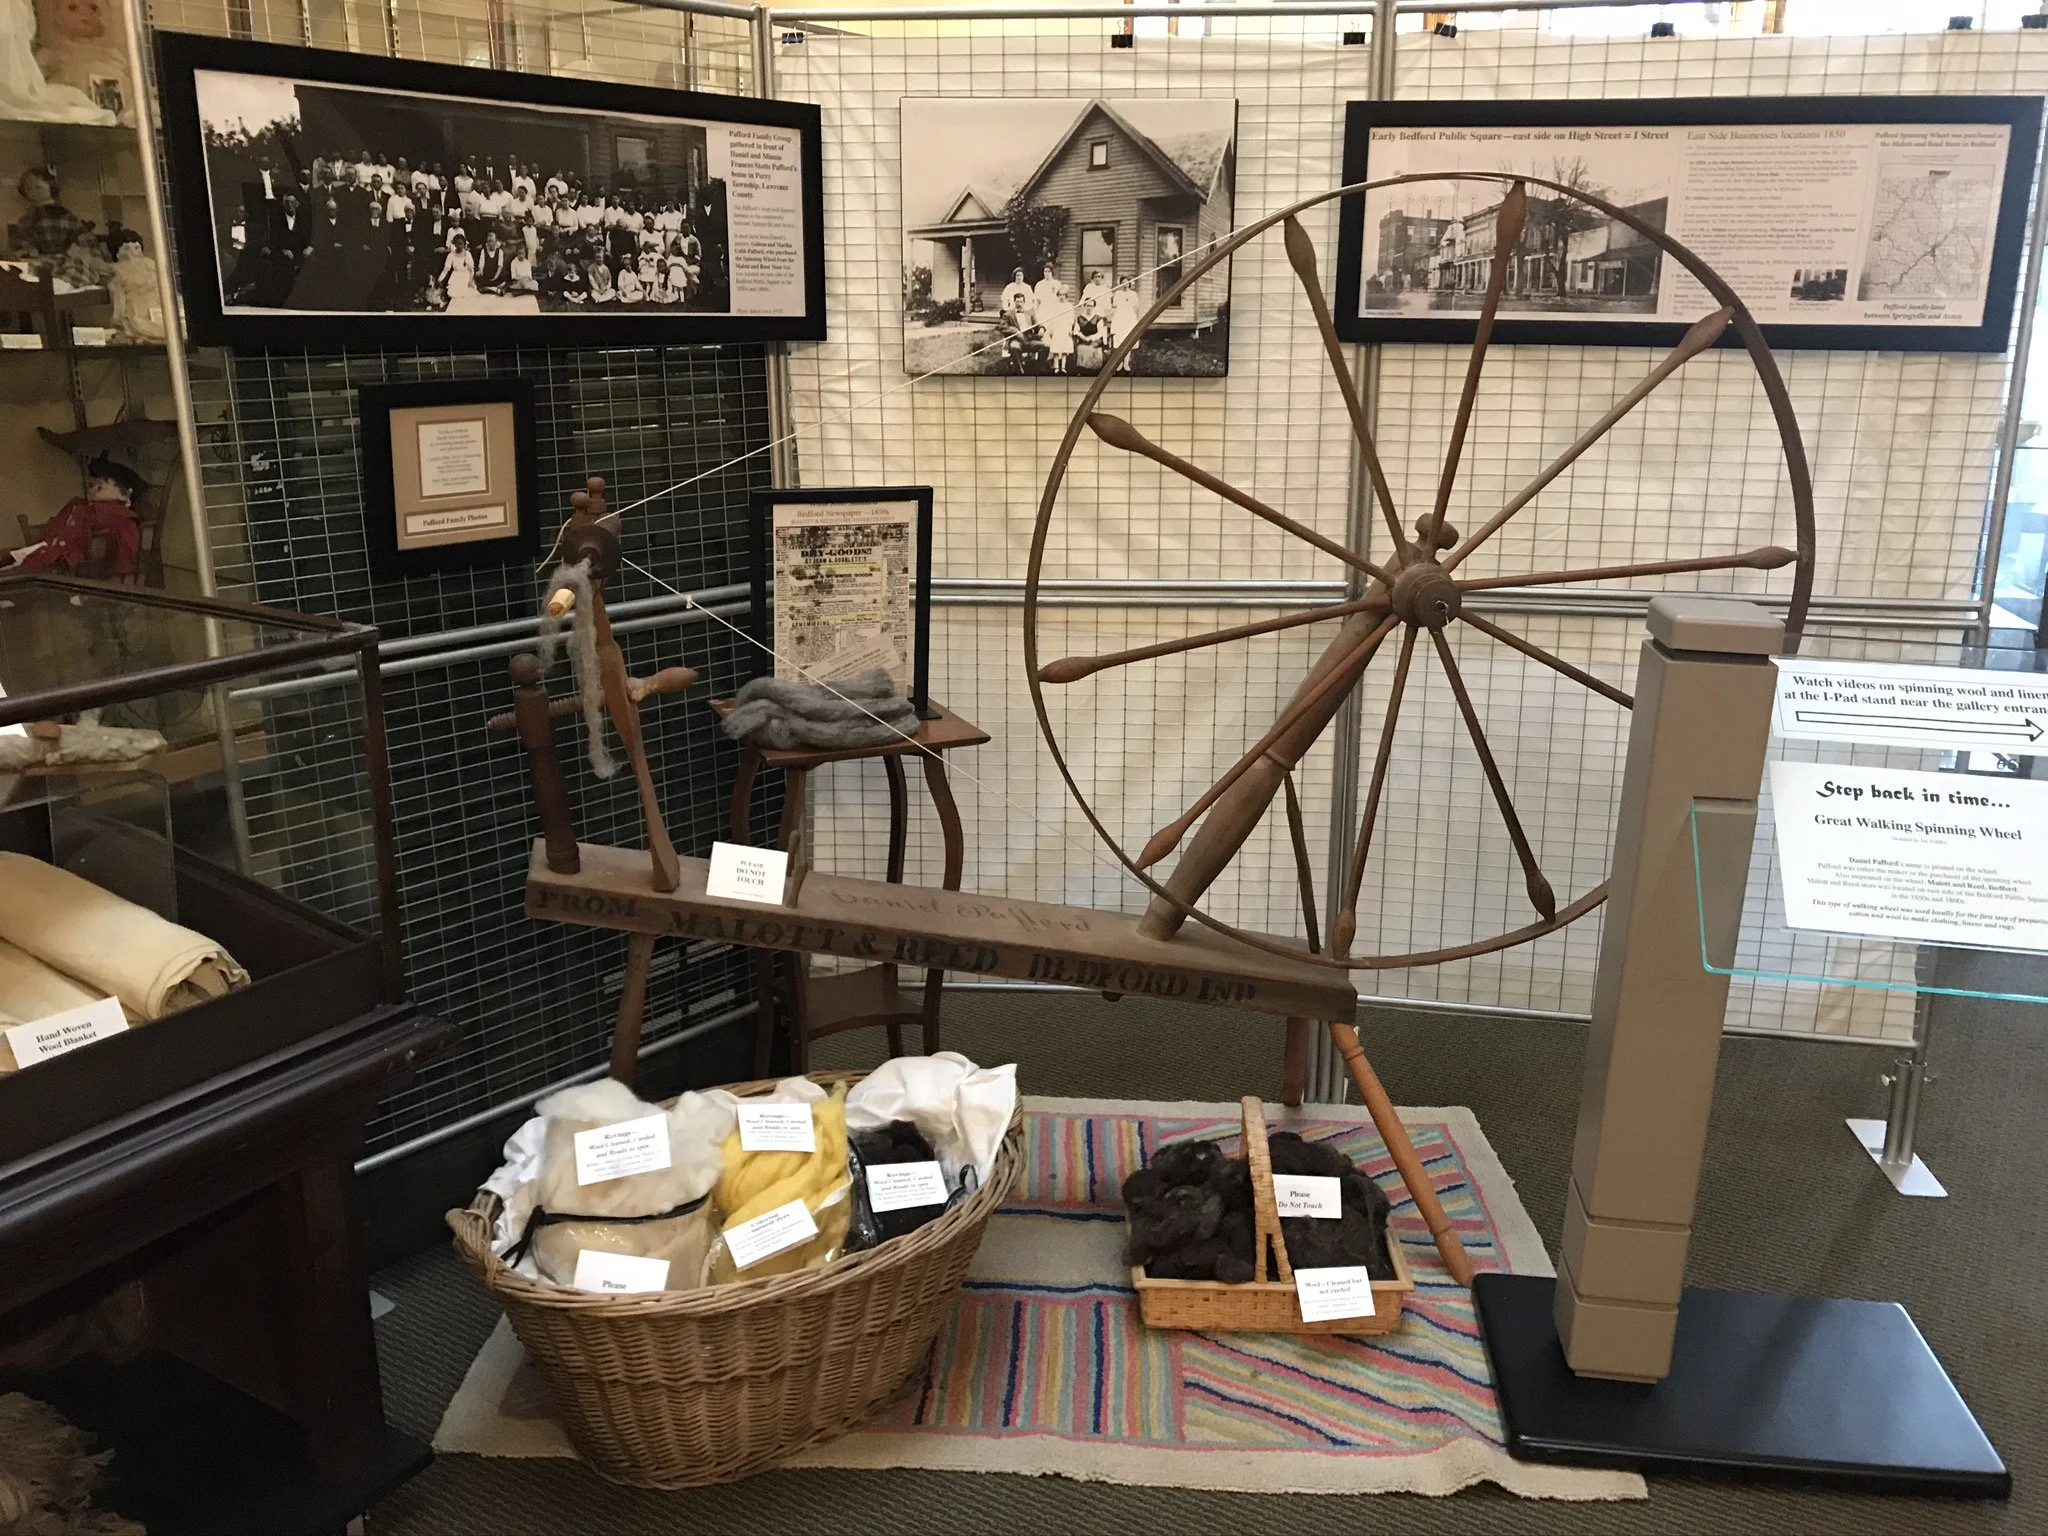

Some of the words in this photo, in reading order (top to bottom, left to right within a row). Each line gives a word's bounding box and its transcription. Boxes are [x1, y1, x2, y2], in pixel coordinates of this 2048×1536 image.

[1372, 131, 1396, 142] Early
[1400, 131, 1436, 141] Bedford
[1439, 131, 1468, 141] Public
[1533, 131, 1552, 140] side
[1568, 130, 1592, 141] High
[1594, 131, 1623, 140] Street
[1641, 131, 1669, 140] Street
[1687, 131, 1706, 141] East
[1708, 131, 1728, 140] Side
[1730, 131, 1778, 140] Businesses
[1823, 130, 1847, 139] 1850
[422, 518, 446, 527] Pafford
[446, 516, 467, 525] Family
[467, 513, 488, 522] Photos
[797, 510, 825, 518] Bedford
[825, 509, 863, 519] Newspaper
[1793, 676, 1832, 688] Watch
[1837, 679, 1876, 690] videos
[1879, 683, 1895, 691] on
[1899, 682, 1954, 697] spinning
[1957, 687, 1986, 697] wool
[1990, 689, 2014, 698] and
[1784, 691, 1797, 700] at
[1800, 690, 1820, 701] the
[1823, 692, 1858, 703] I-Pad
[1862, 696, 1896, 706] stand
[1900, 698, 1929, 707] near
[1932, 699, 1953, 709] the
[1956, 701, 2000, 714] gallery
[2004, 705, 2048, 715] entran
[1815, 781, 1864, 801] Step
[1871, 785, 1915, 801] back
[1922, 788, 1940, 803] in
[1814, 814, 1852, 827] Great
[1856, 817, 1913, 833] Walking
[1915, 821, 1977, 839] Spinning
[1979, 826, 2023, 840] Wheel
[741, 860, 764, 868] PLEASE
[1848, 857, 1872, 865] Daniel
[736, 876, 764, 886] TOUCH
[536, 890, 638, 918] FROM
[664, 910, 845, 954] MALOTT
[852, 930, 879, 954] &
[893, 934, 999, 974] REED
[1026, 952, 1193, 998] BEDFORD
[36, 1030, 61, 1043] Hand
[62, 1021, 92, 1034] Woven
[38, 1041, 62, 1053] Wool
[64, 1030, 97, 1047] Blanket
[1289, 1190, 1310, 1198] Please
[1289, 1201, 1301, 1209] Not
[1302, 1201, 1323, 1209] Touch
[602, 1280, 627, 1290] Please
